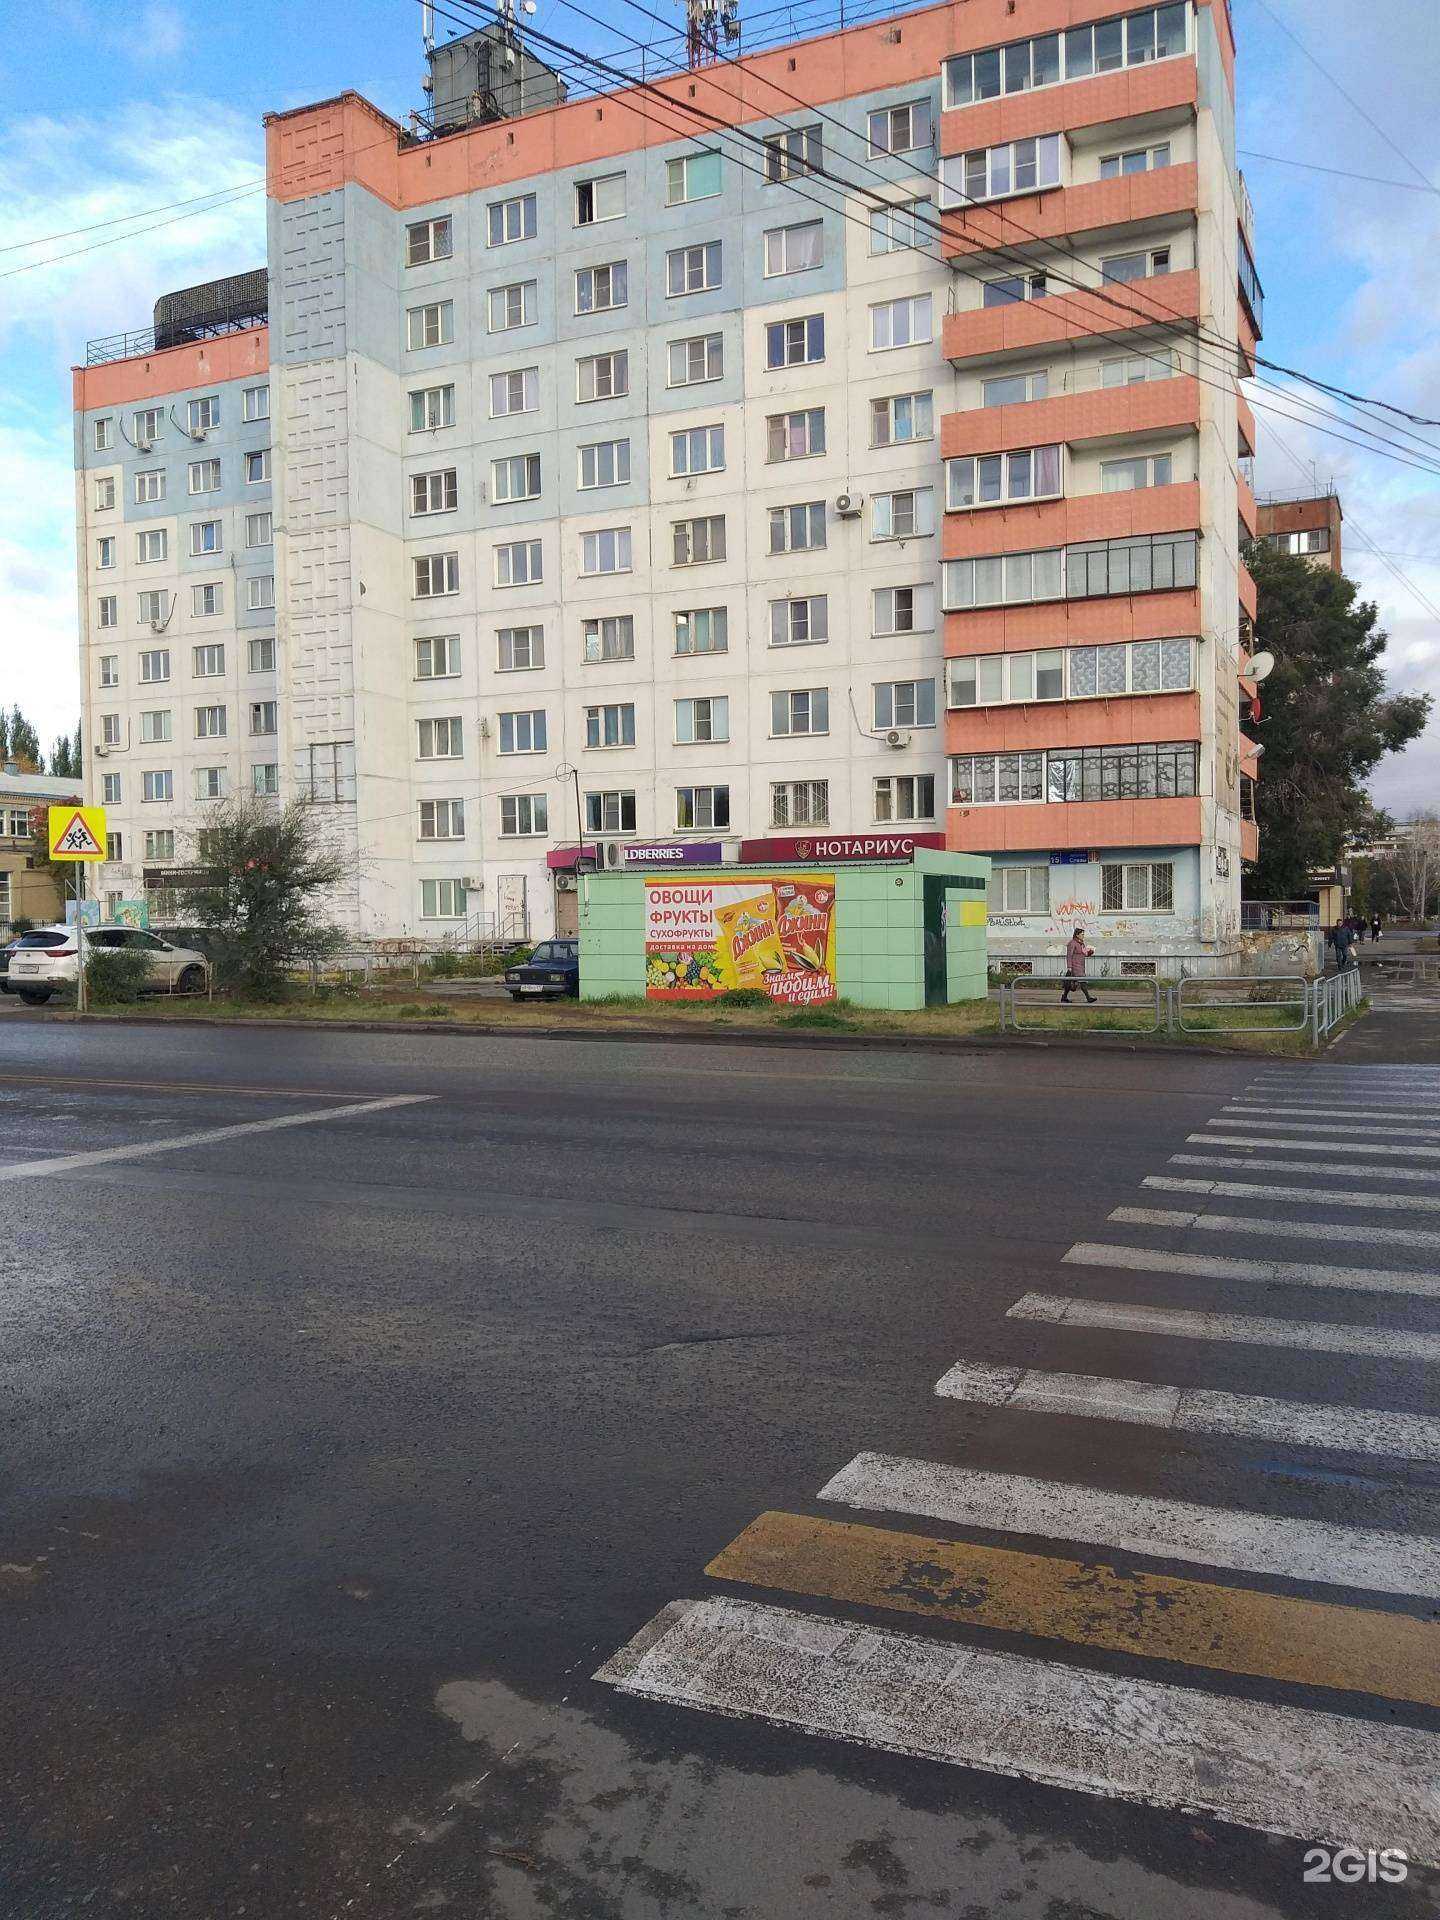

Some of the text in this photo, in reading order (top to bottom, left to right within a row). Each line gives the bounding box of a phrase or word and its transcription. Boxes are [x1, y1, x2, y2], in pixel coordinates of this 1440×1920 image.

[624, 848, 684, 860] LDBERRIES
[815, 839, 914, 856] НОТАРИУС
[649, 889, 713, 905] ОВОЩИ
[649, 909, 713, 926] ФРУКТЫ
[650, 929, 713, 939] СУХОФРУКТЫ
